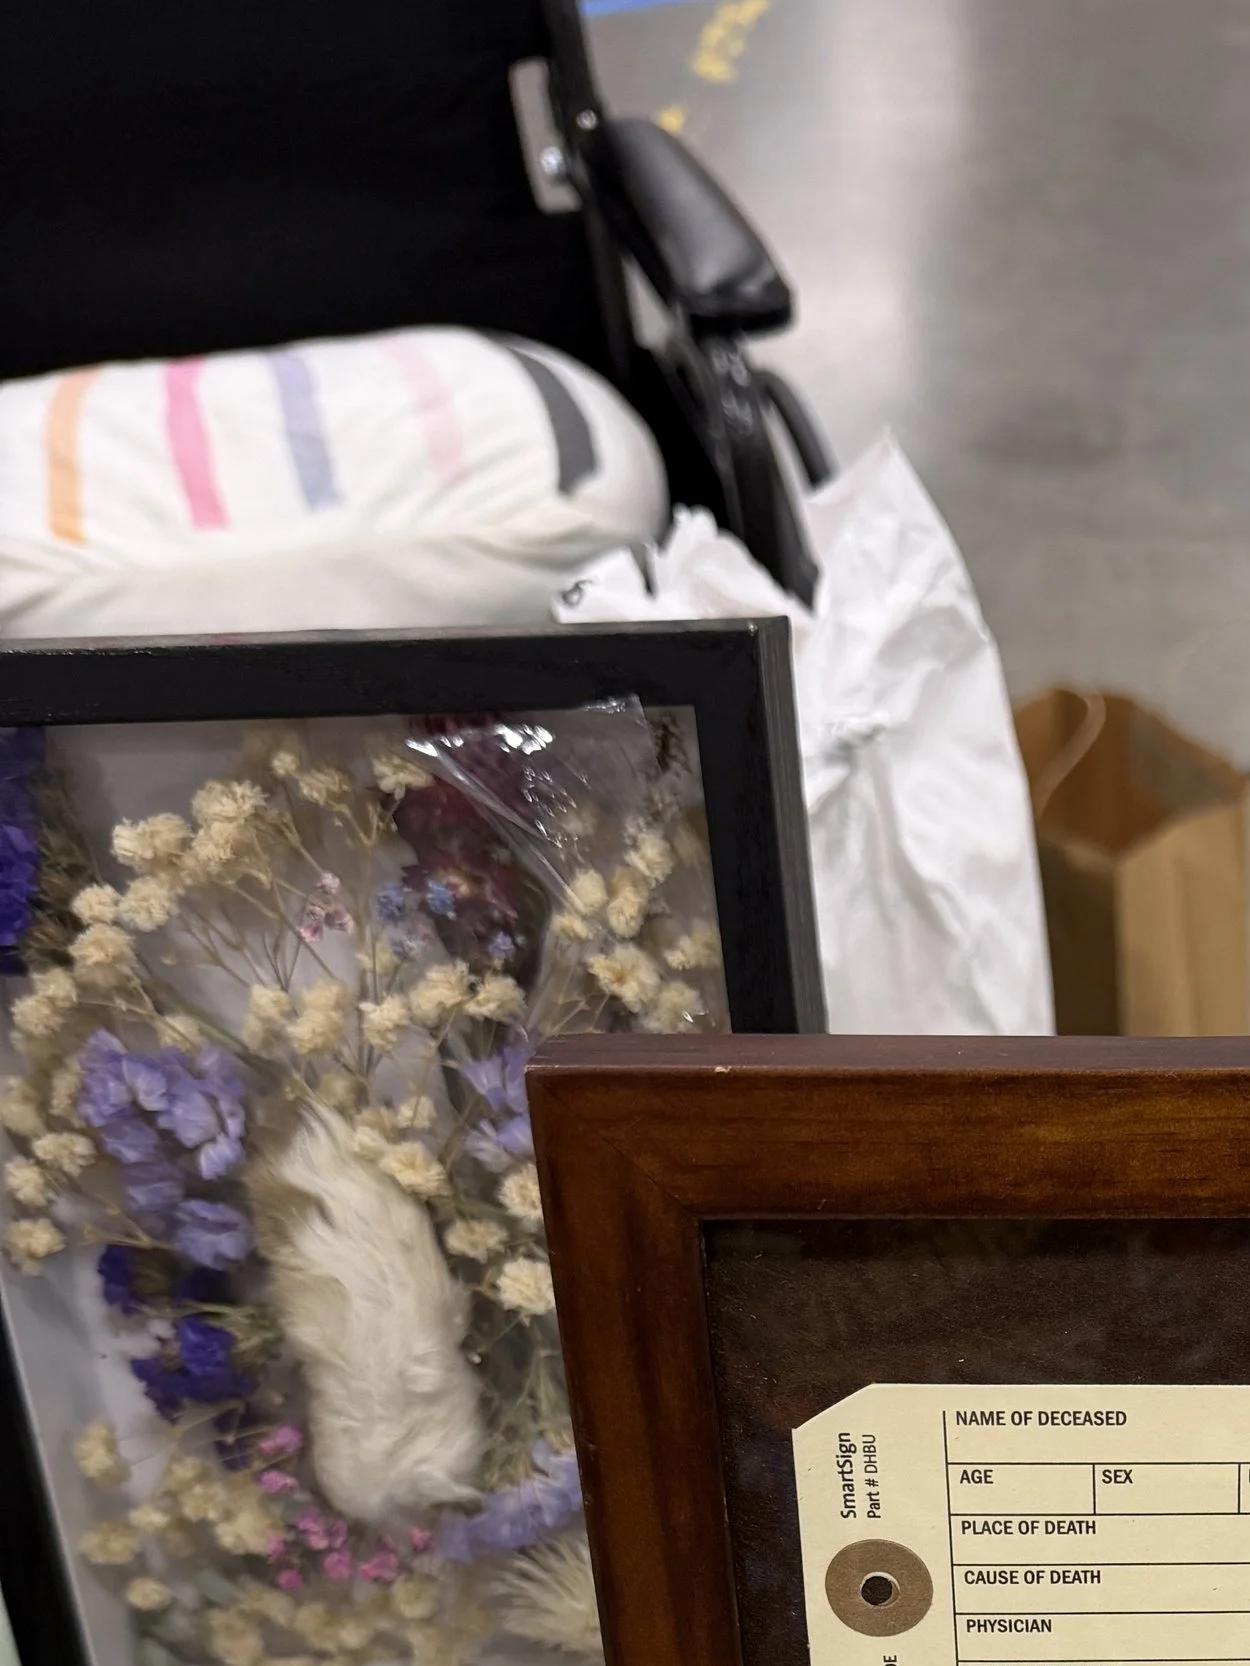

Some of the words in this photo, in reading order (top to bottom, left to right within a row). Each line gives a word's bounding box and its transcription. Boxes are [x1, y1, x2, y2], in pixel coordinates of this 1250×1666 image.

[954, 1409, 1008, 1427] NAME
[1010, 1409, 1034, 1427] OF
[1037, 1409, 1128, 1428] DECEASED
[861, 1434, 878, 1474] DHBU
[836, 1432, 858, 1519] SmartSign
[864, 1477, 879, 1488] #
[959, 1469, 994, 1485] AGE
[1101, 1469, 1134, 1485] SEX
[866, 1491, 882, 1519] Part
[961, 1520, 1014, 1535] PLACE
[1016, 1519, 1041, 1537] OF
[1044, 1520, 1096, 1535] DEATH
[964, 1570, 1020, 1585] CAUSE
[1022, 1568, 1046, 1586] OF
[1049, 1569, 1101, 1585] DEATH
[966, 1618, 1052, 1633] PHYSICIAN
